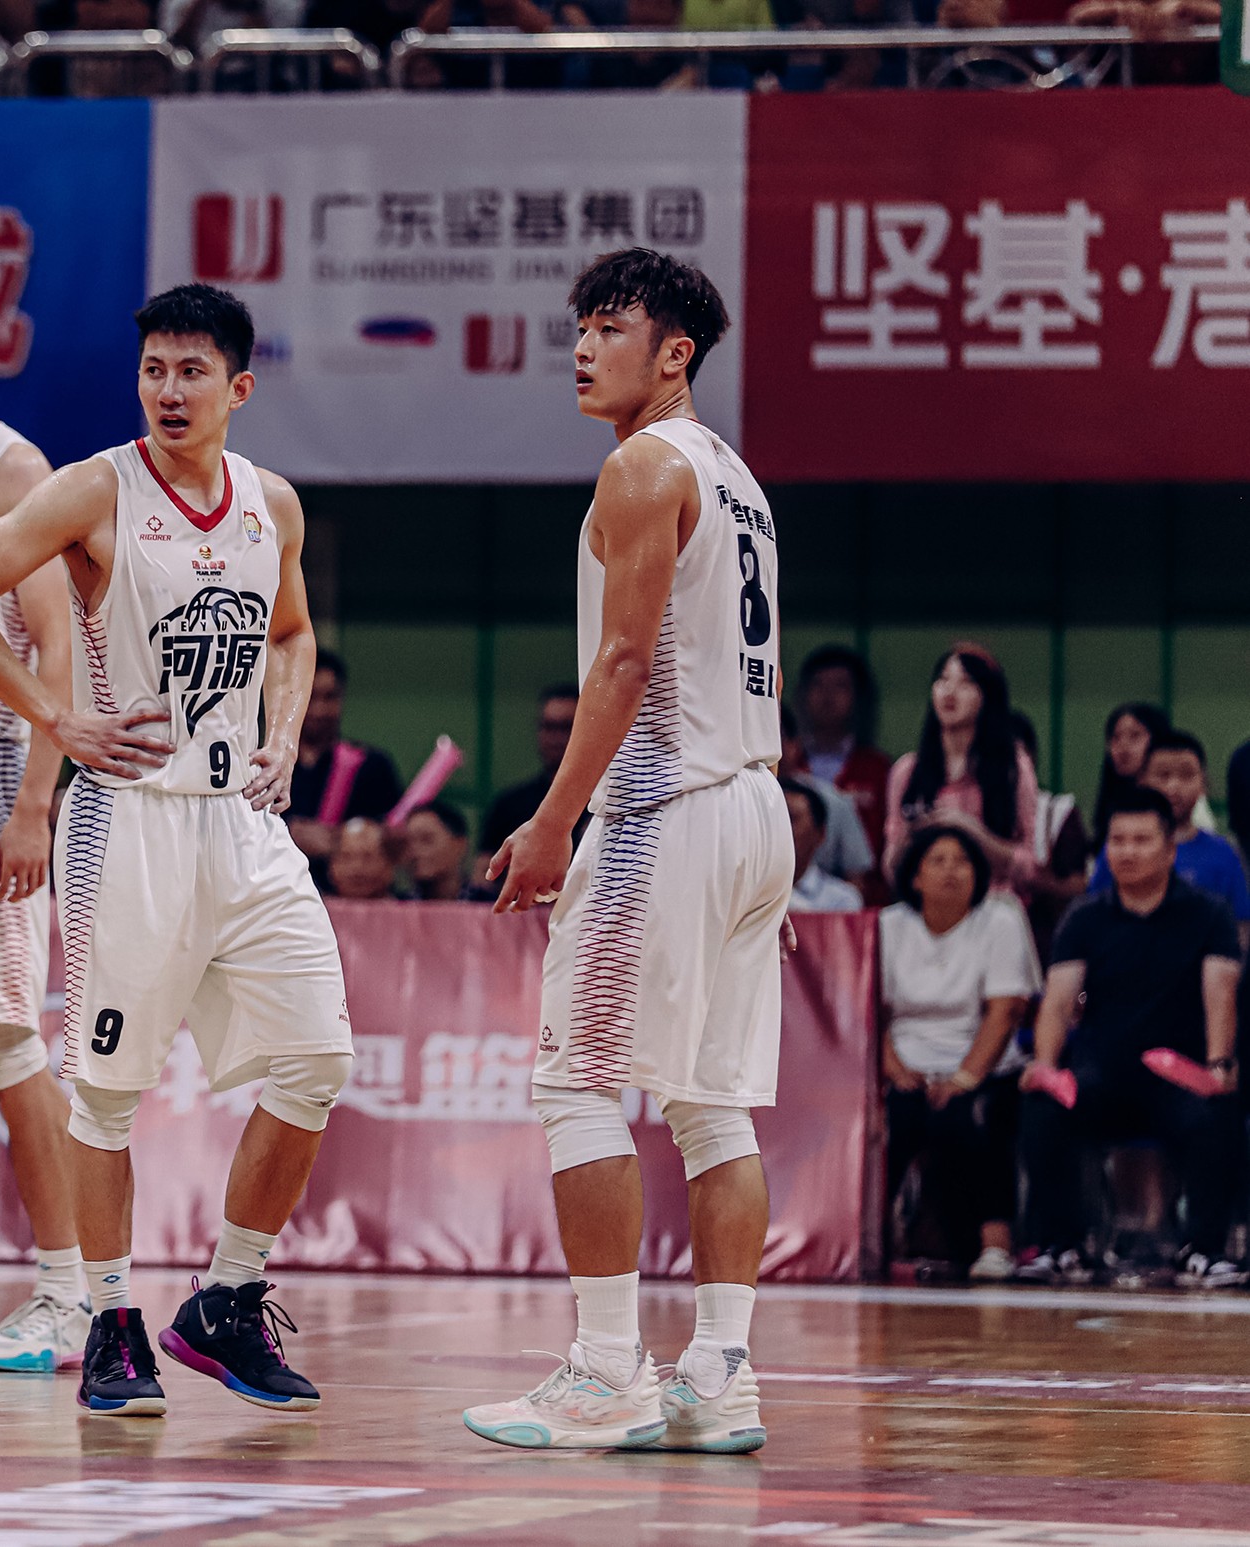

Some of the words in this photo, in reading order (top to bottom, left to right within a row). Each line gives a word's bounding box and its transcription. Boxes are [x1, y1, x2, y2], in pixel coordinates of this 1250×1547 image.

[311, 187, 705, 247] 广东坚基集团
[138, 534, 172, 542] RIGORER
[737, 533, 771, 646] 8
[161, 620, 267, 633] HEYUAN
[158, 634, 266, 695] 河源
[208, 741, 231, 789] 9
[91, 1008, 123, 1056] 9
